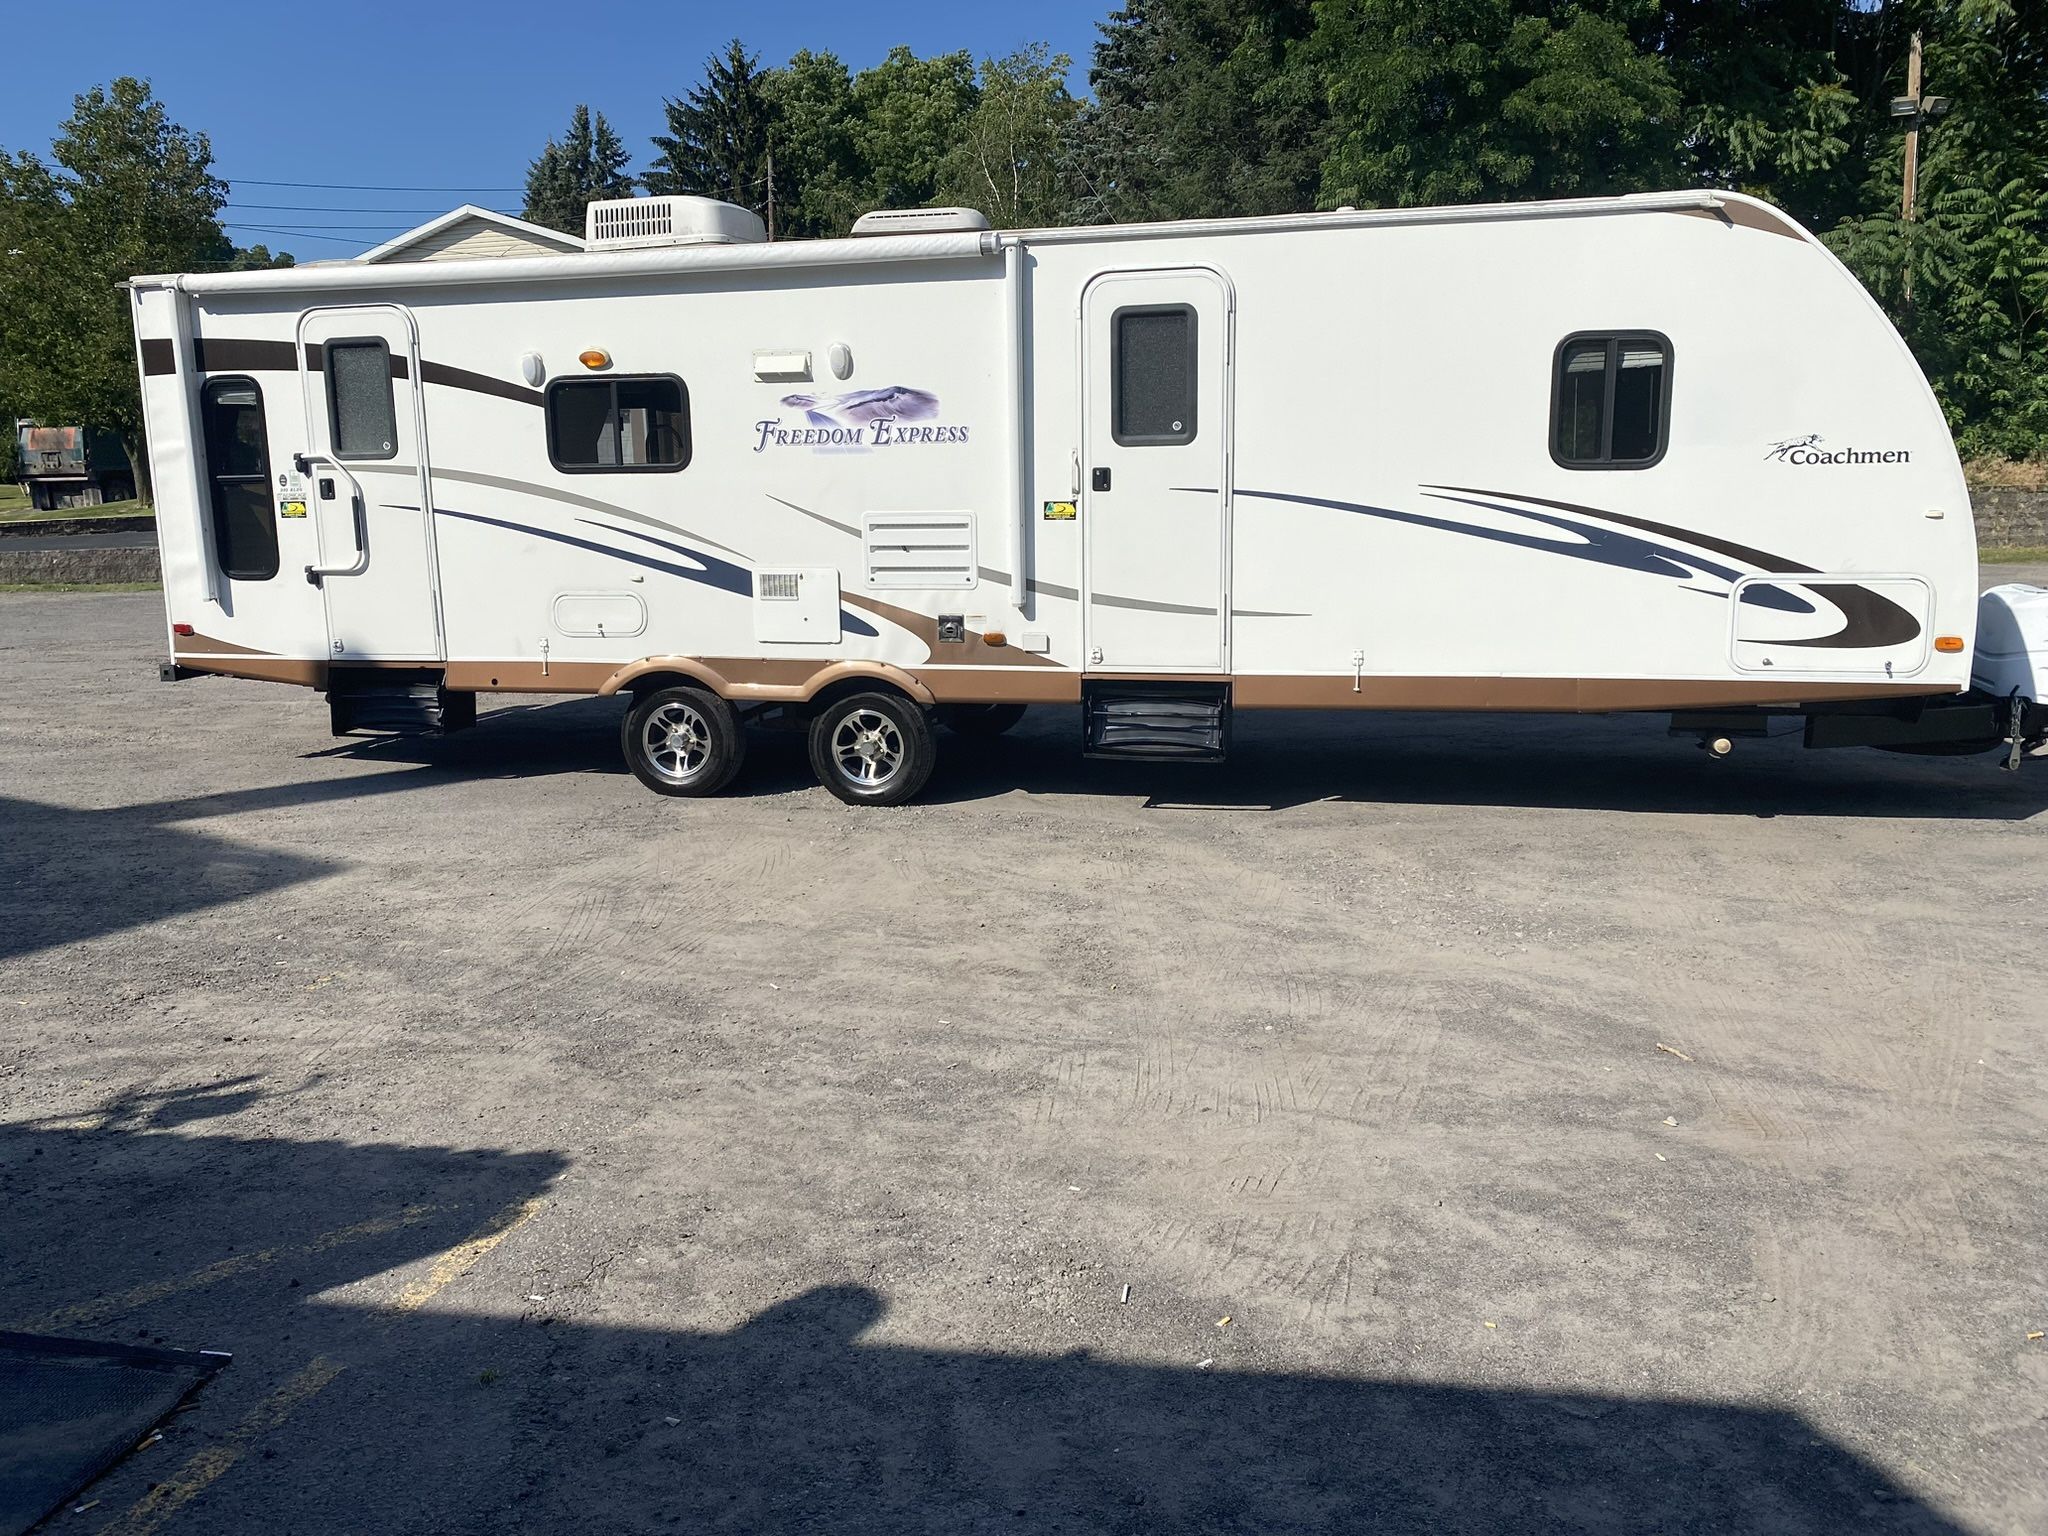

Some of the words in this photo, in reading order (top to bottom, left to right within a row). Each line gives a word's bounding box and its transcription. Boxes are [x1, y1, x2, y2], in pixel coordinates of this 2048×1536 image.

[753, 417, 863, 453] FREEDOM
[869, 415, 970, 446] EXPRESS
[1789, 447, 1910, 465] Coachmen
